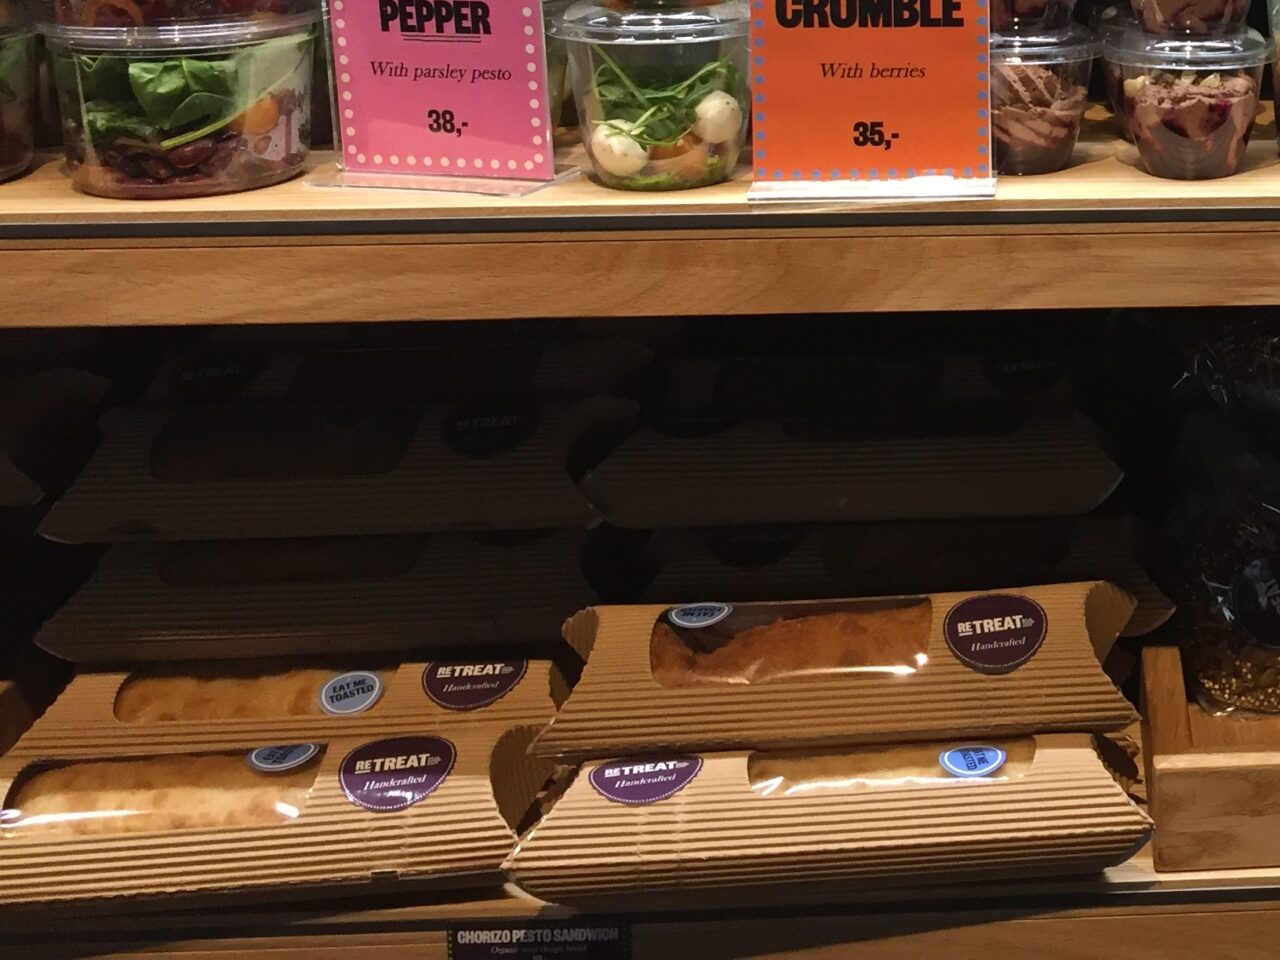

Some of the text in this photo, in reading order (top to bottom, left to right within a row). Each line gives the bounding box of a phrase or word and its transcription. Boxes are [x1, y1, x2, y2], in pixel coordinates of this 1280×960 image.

[370, 61, 512, 83] With parsley pesto
[820, 63, 926, 79] With berries
[427, 109, 469, 138] 38,-
[853, 121, 900, 150] 35,-
[957, 614, 1023, 637] RETREAT
[971, 636, 1026, 652] Handcrafted
[436, 663, 505, 678] RETREAT
[329, 684, 374, 704] TOASTED
[332, 678, 368, 693] EAT ME
[355, 753, 431, 774] RETREAT
[604, 761, 678, 778] RETREAT
[363, 774, 427, 790] Handcrafted
[615, 774, 677, 788] Handcrafted
[457, 927, 619, 944] CHORIZO PESTO SANDWICH
